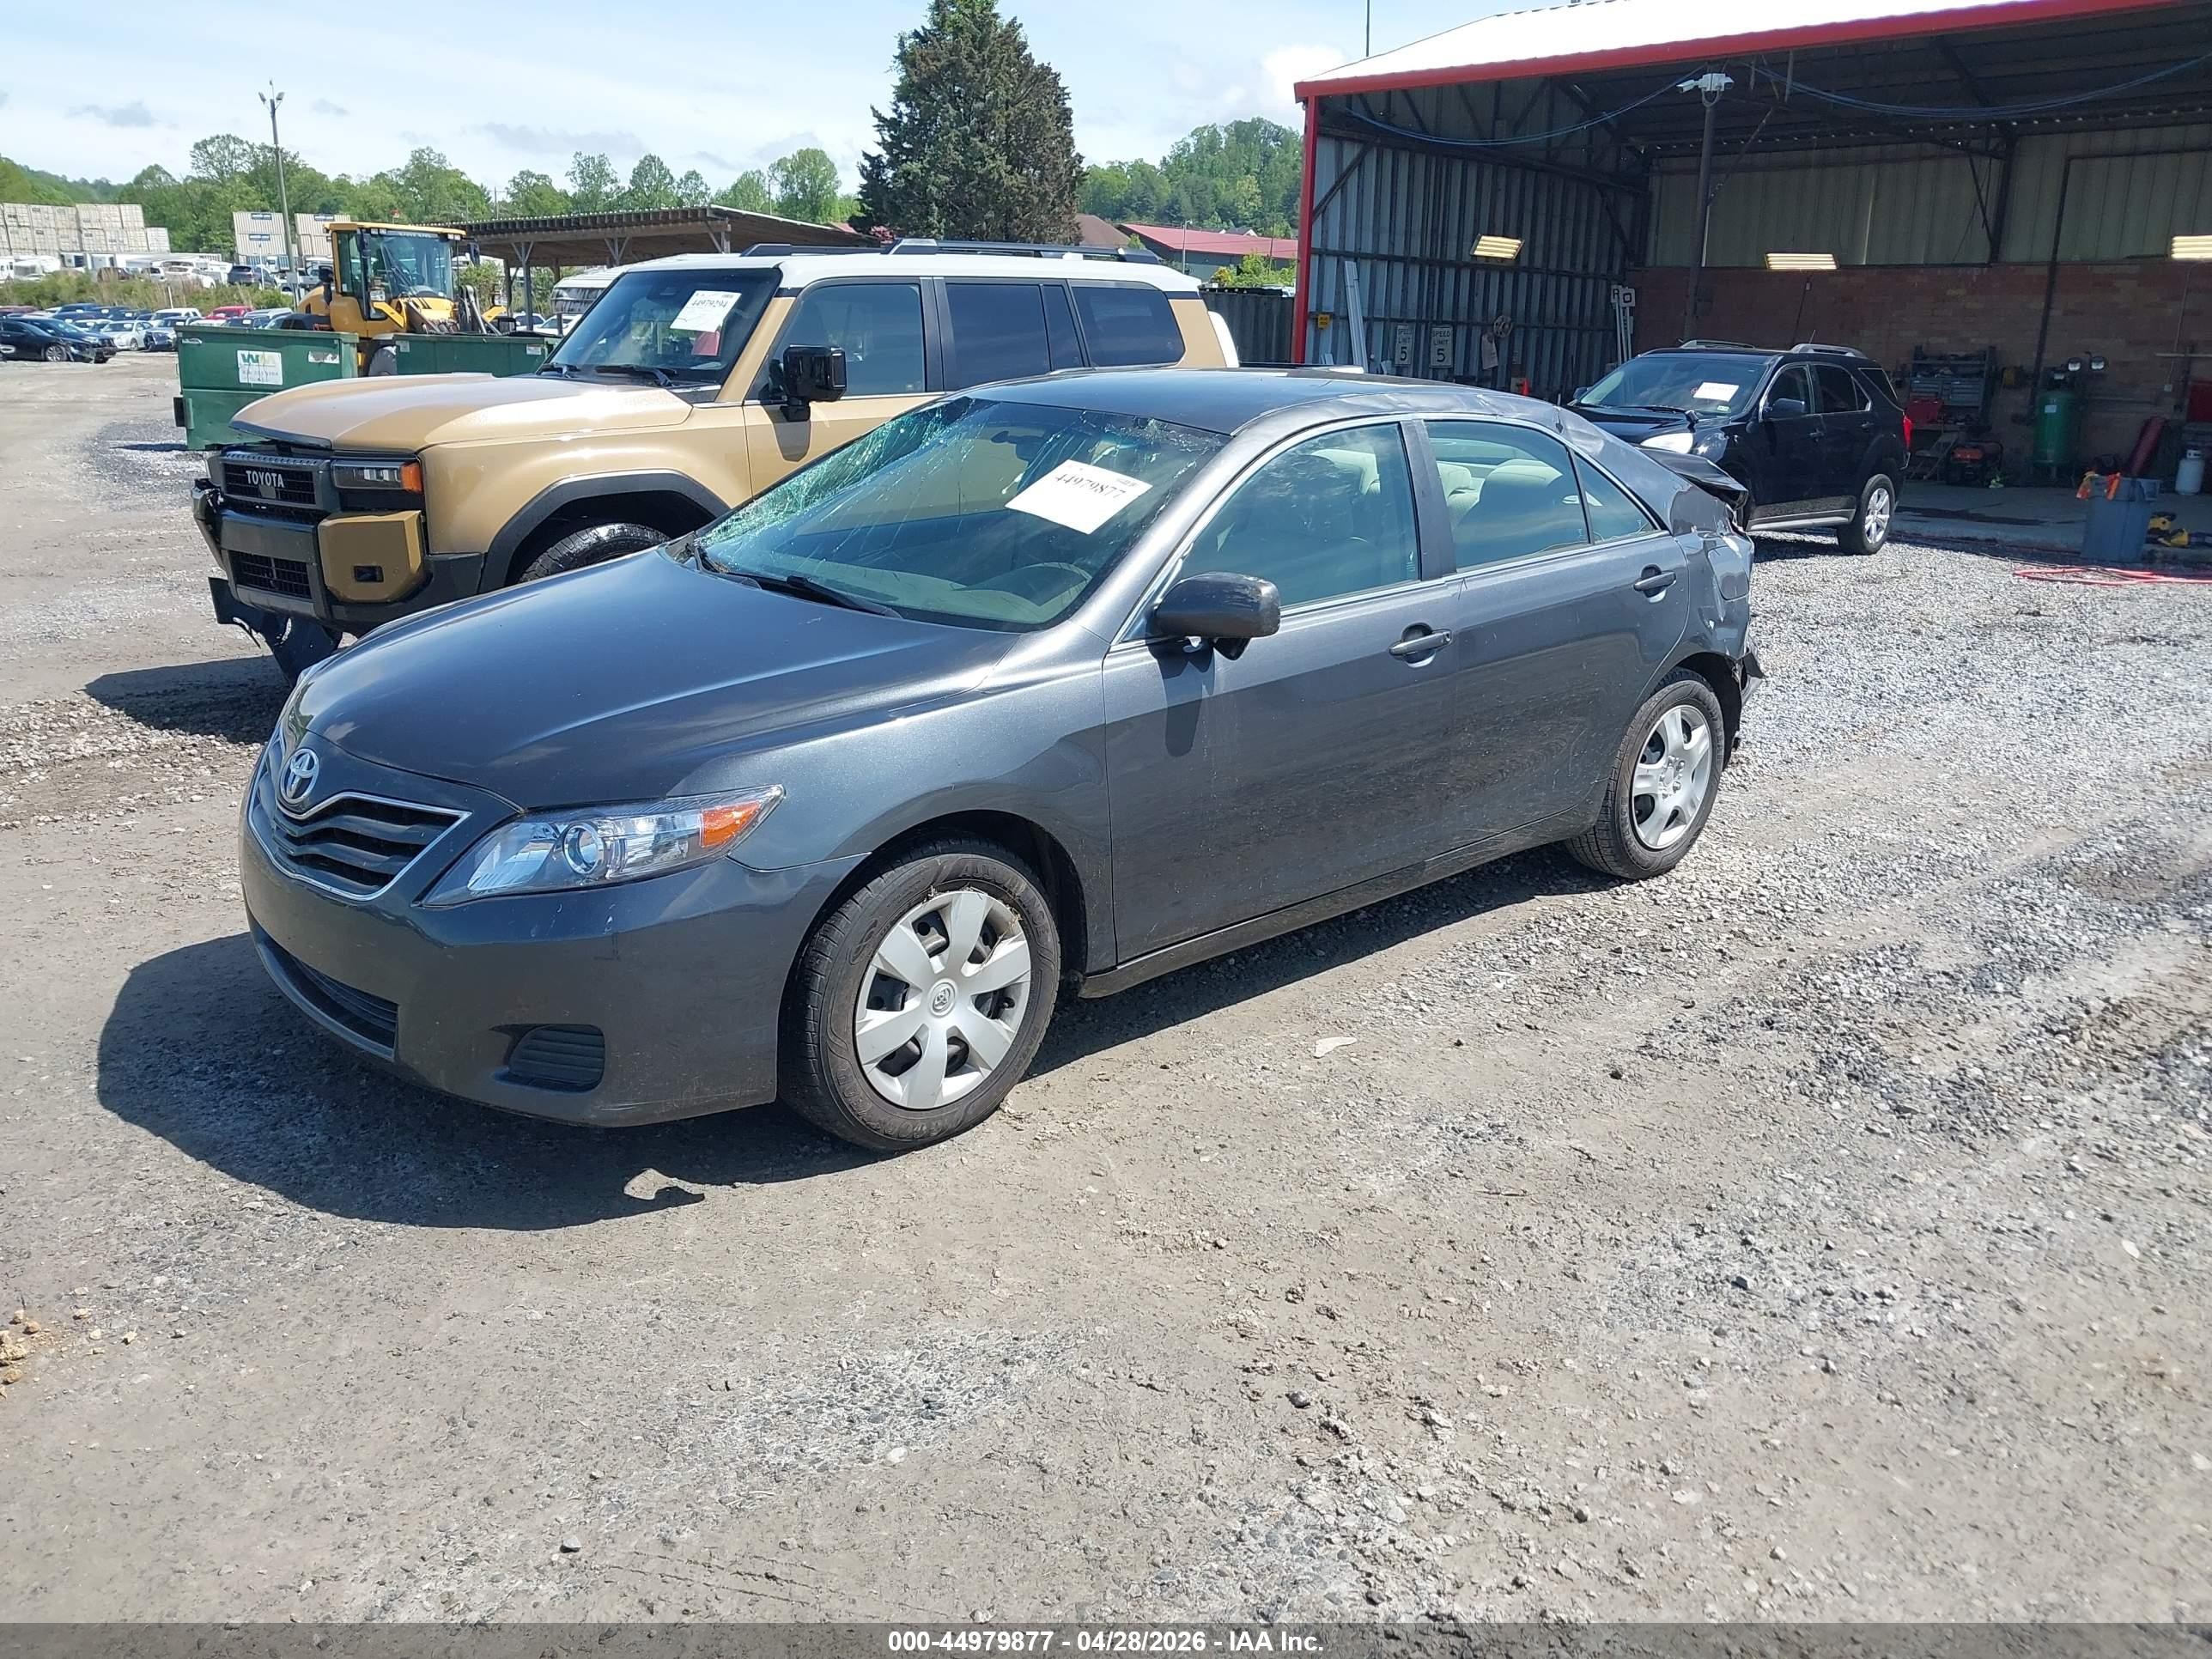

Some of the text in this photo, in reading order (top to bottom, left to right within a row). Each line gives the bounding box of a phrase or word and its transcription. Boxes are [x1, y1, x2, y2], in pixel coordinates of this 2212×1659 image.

[1400, 346, 1407, 362] 5
[1437, 348, 1446, 362] 5
[246, 470, 285, 489] TOYOTA
[1055, 473, 1127, 499] 44979877
